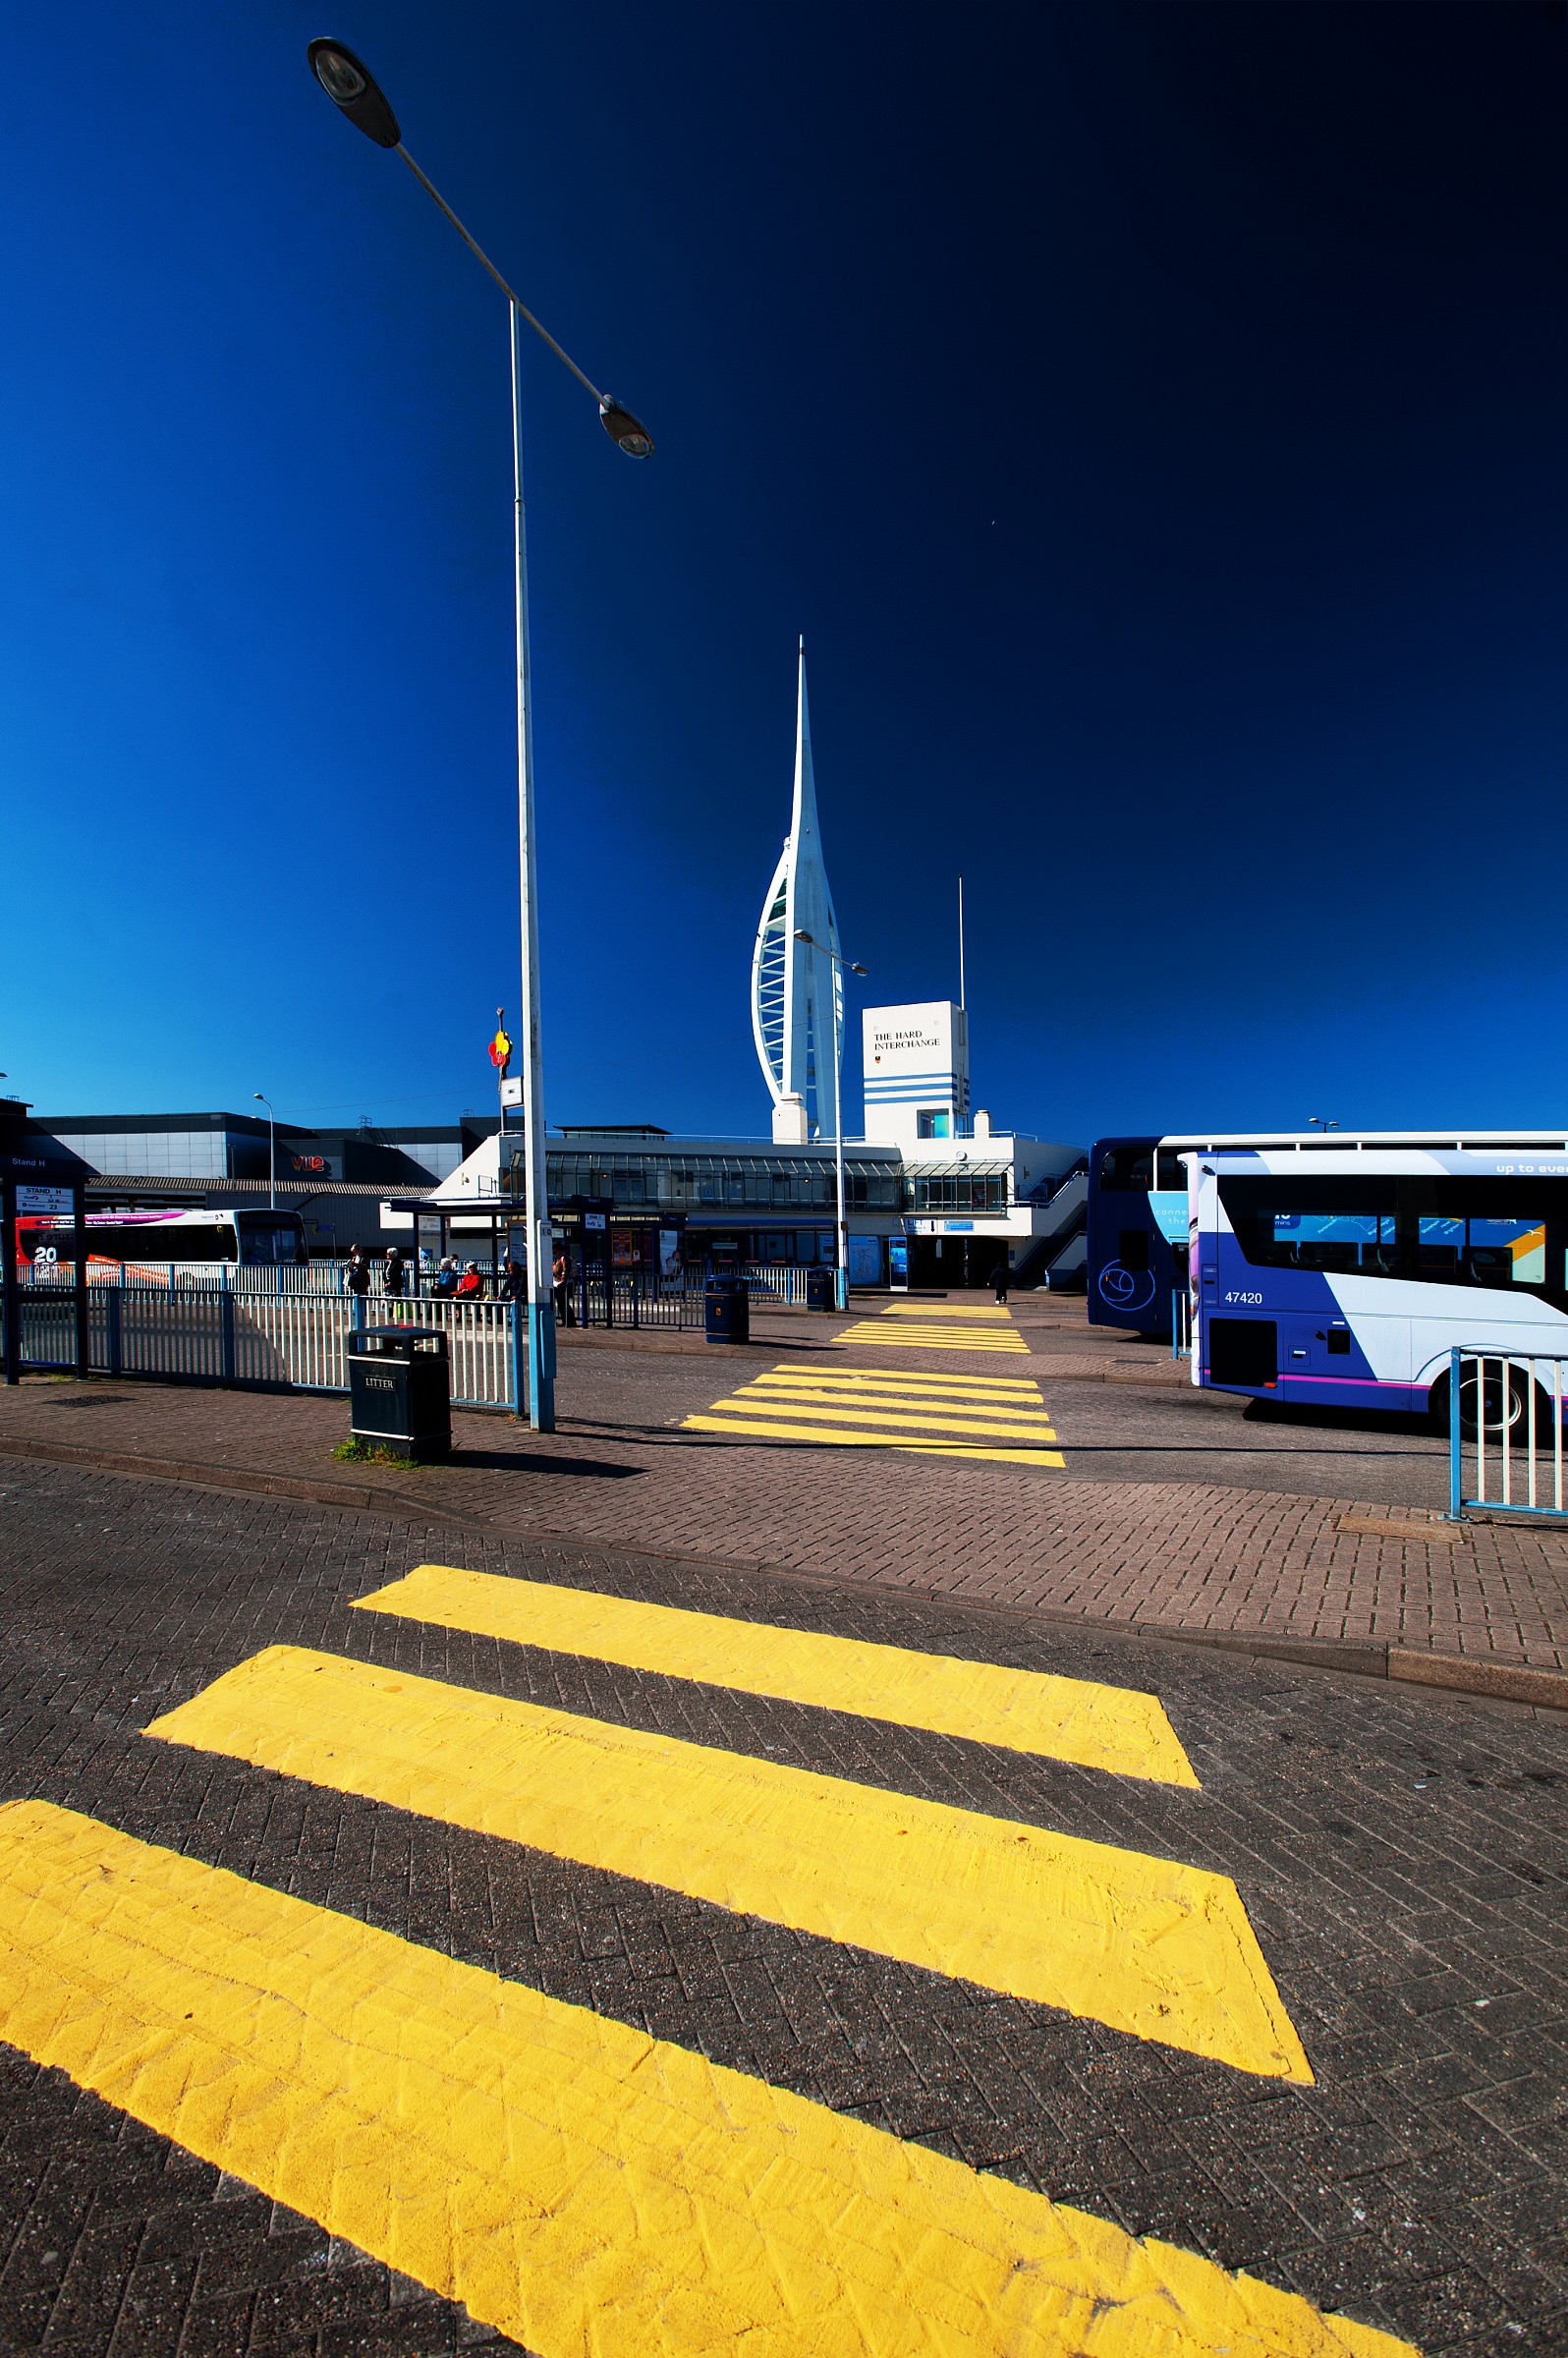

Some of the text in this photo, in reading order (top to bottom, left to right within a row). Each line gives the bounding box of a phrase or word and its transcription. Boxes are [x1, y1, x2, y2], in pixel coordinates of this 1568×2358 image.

[895, 1031, 923, 1039] HARD
[874, 1039, 940, 1050] INTERCHANGE
[12, 1157, 36, 1166] Stand
[1496, 1165, 1515, 1175] up
[1518, 1163, 1536, 1173] to
[34, 1246, 57, 1263] 20
[1224, 1292, 1262, 1304] 47420
[365, 1377, 393, 1388] LITTER
